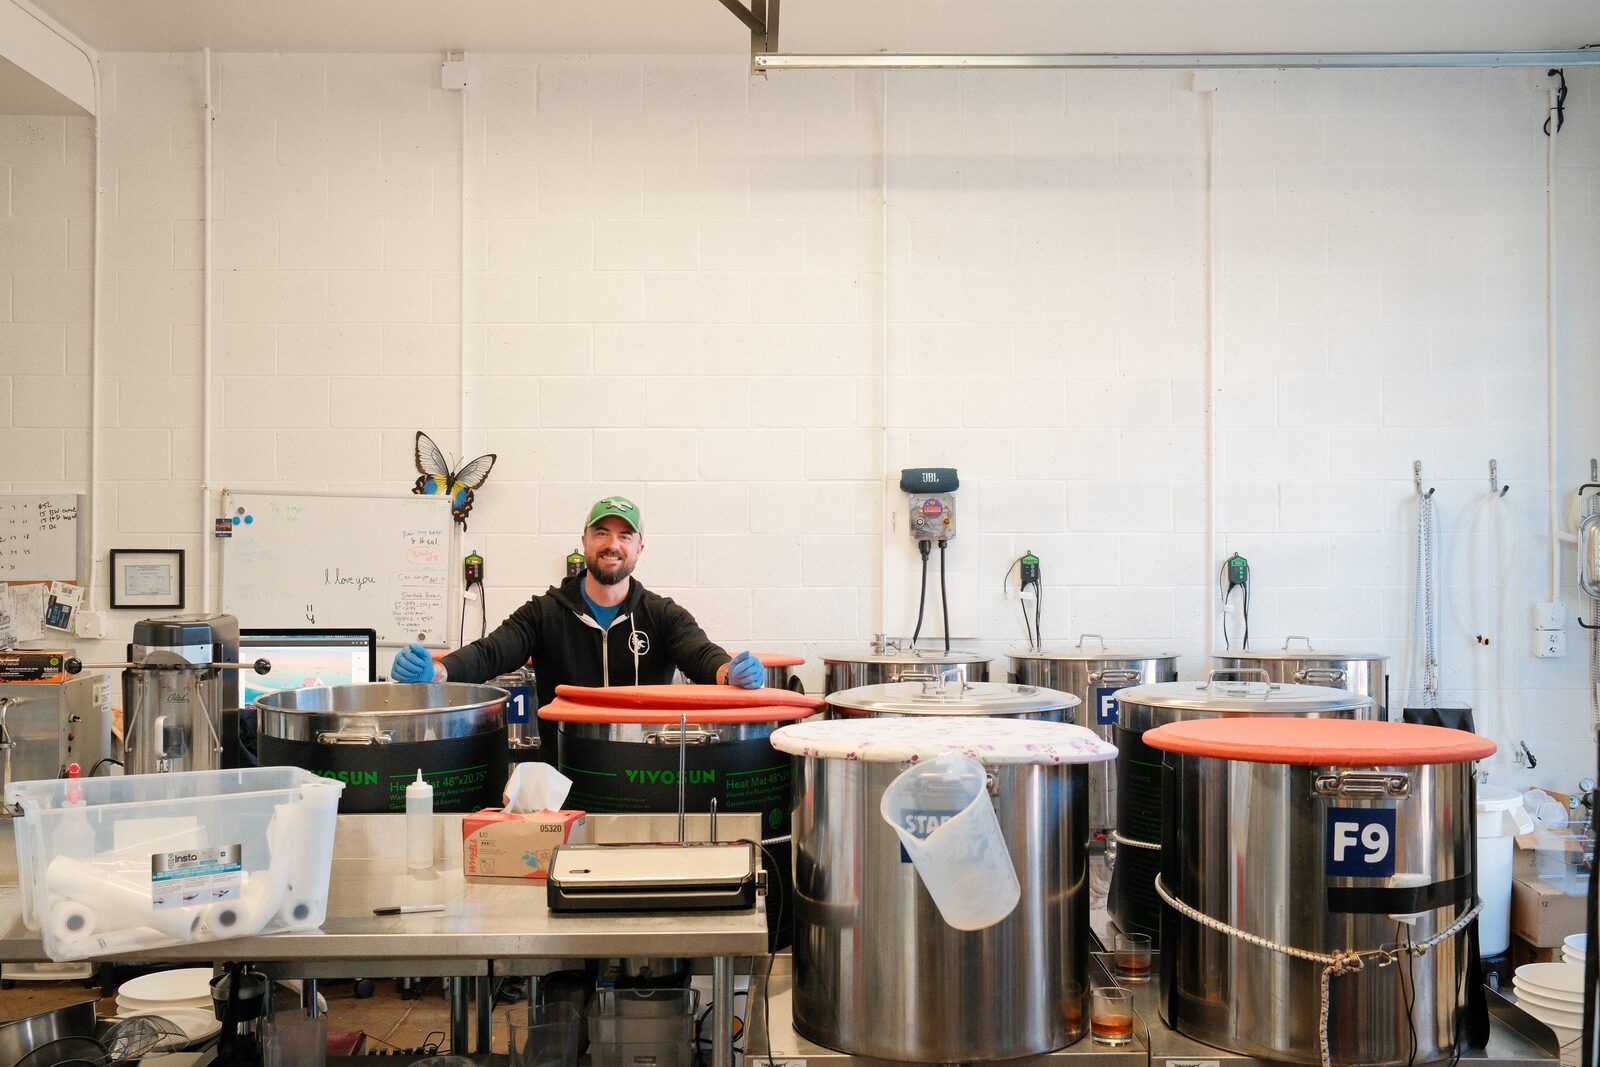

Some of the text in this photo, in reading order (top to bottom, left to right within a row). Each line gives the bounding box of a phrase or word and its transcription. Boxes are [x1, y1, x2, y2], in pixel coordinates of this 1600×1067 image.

[922, 472, 939, 482] JBL
[334, 567, 355, 585] love
[355, 576, 376, 591] you
[506, 694, 525, 716] 1
[1101, 695, 1119, 717] F
[317, 769, 378, 785] OSUN
[625, 769, 716, 785] VIVOSUN
[726, 779, 748, 789] Heat
[751, 776, 767, 786] Mat
[540, 824, 562, 833] 05320
[1333, 821, 1390, 864] F9
[174, 853, 198, 863] Insta
